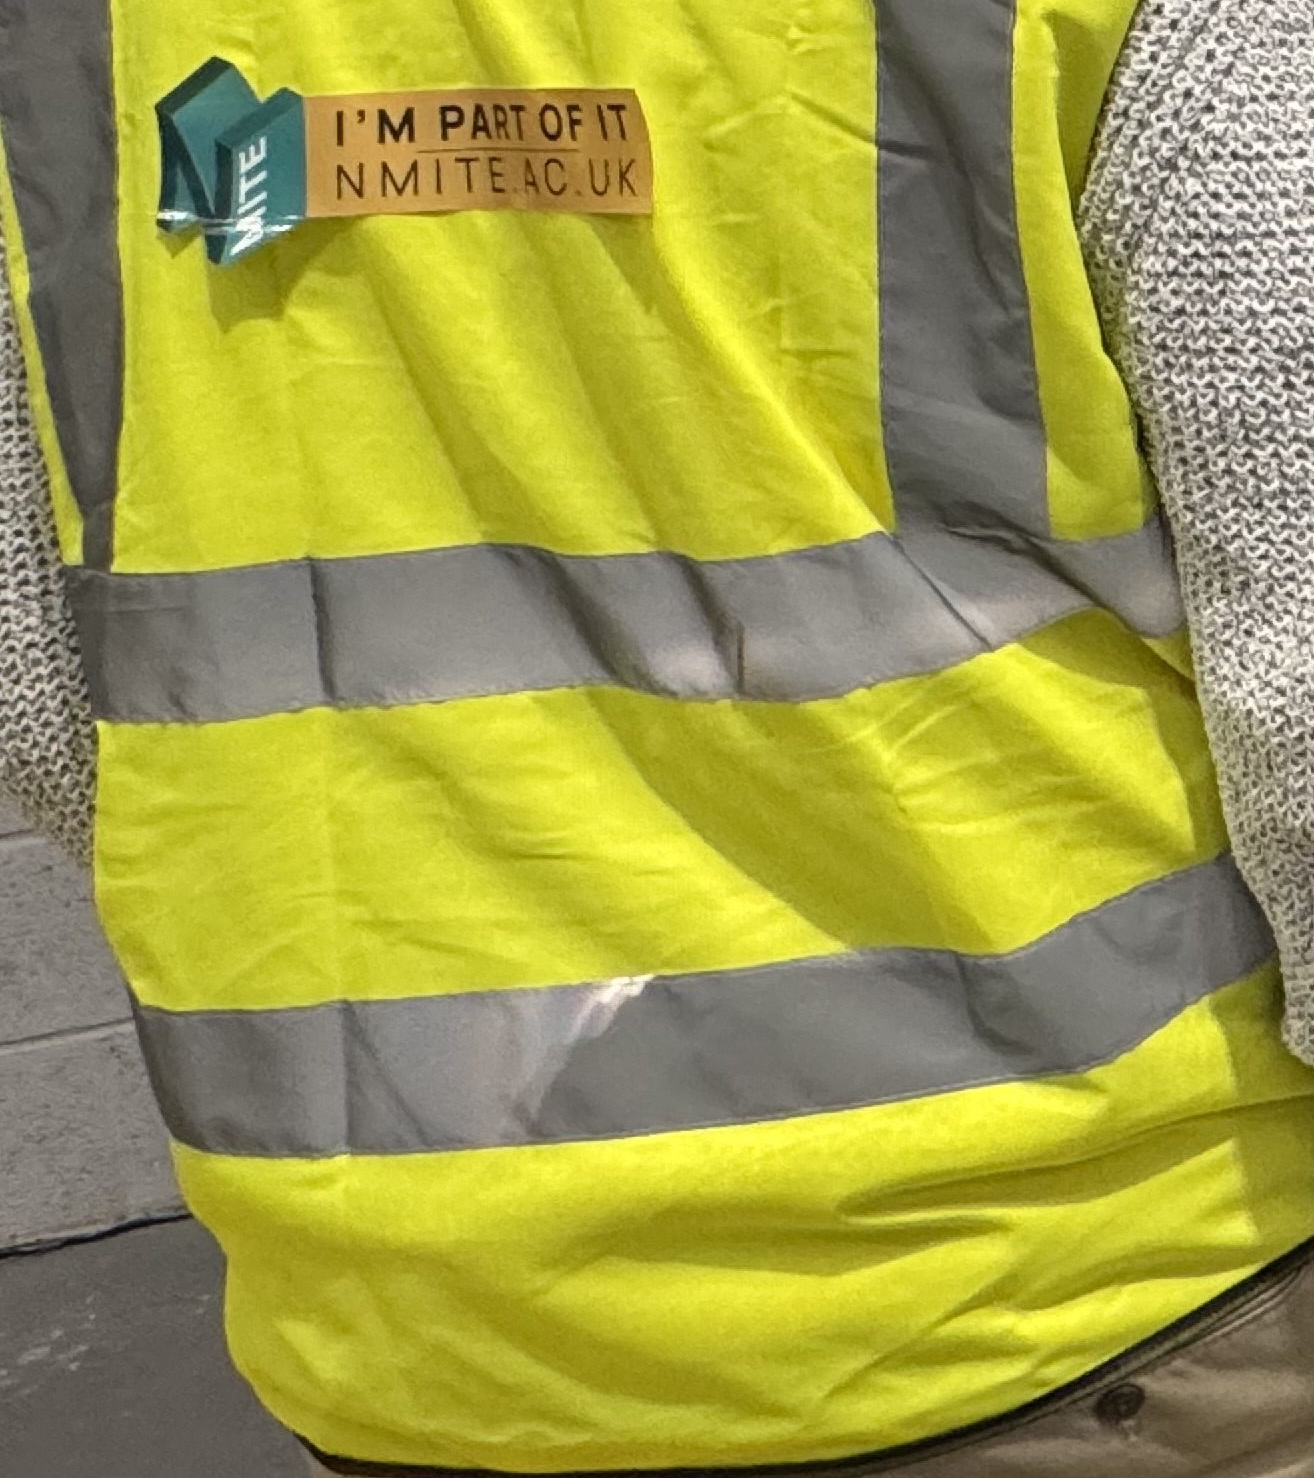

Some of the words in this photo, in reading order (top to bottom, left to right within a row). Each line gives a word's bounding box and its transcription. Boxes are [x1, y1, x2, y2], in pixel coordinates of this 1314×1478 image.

[336, 106, 415, 147] I'M
[439, 103, 526, 141] PART
[539, 103, 582, 141] OF
[596, 104, 627, 141] IT
